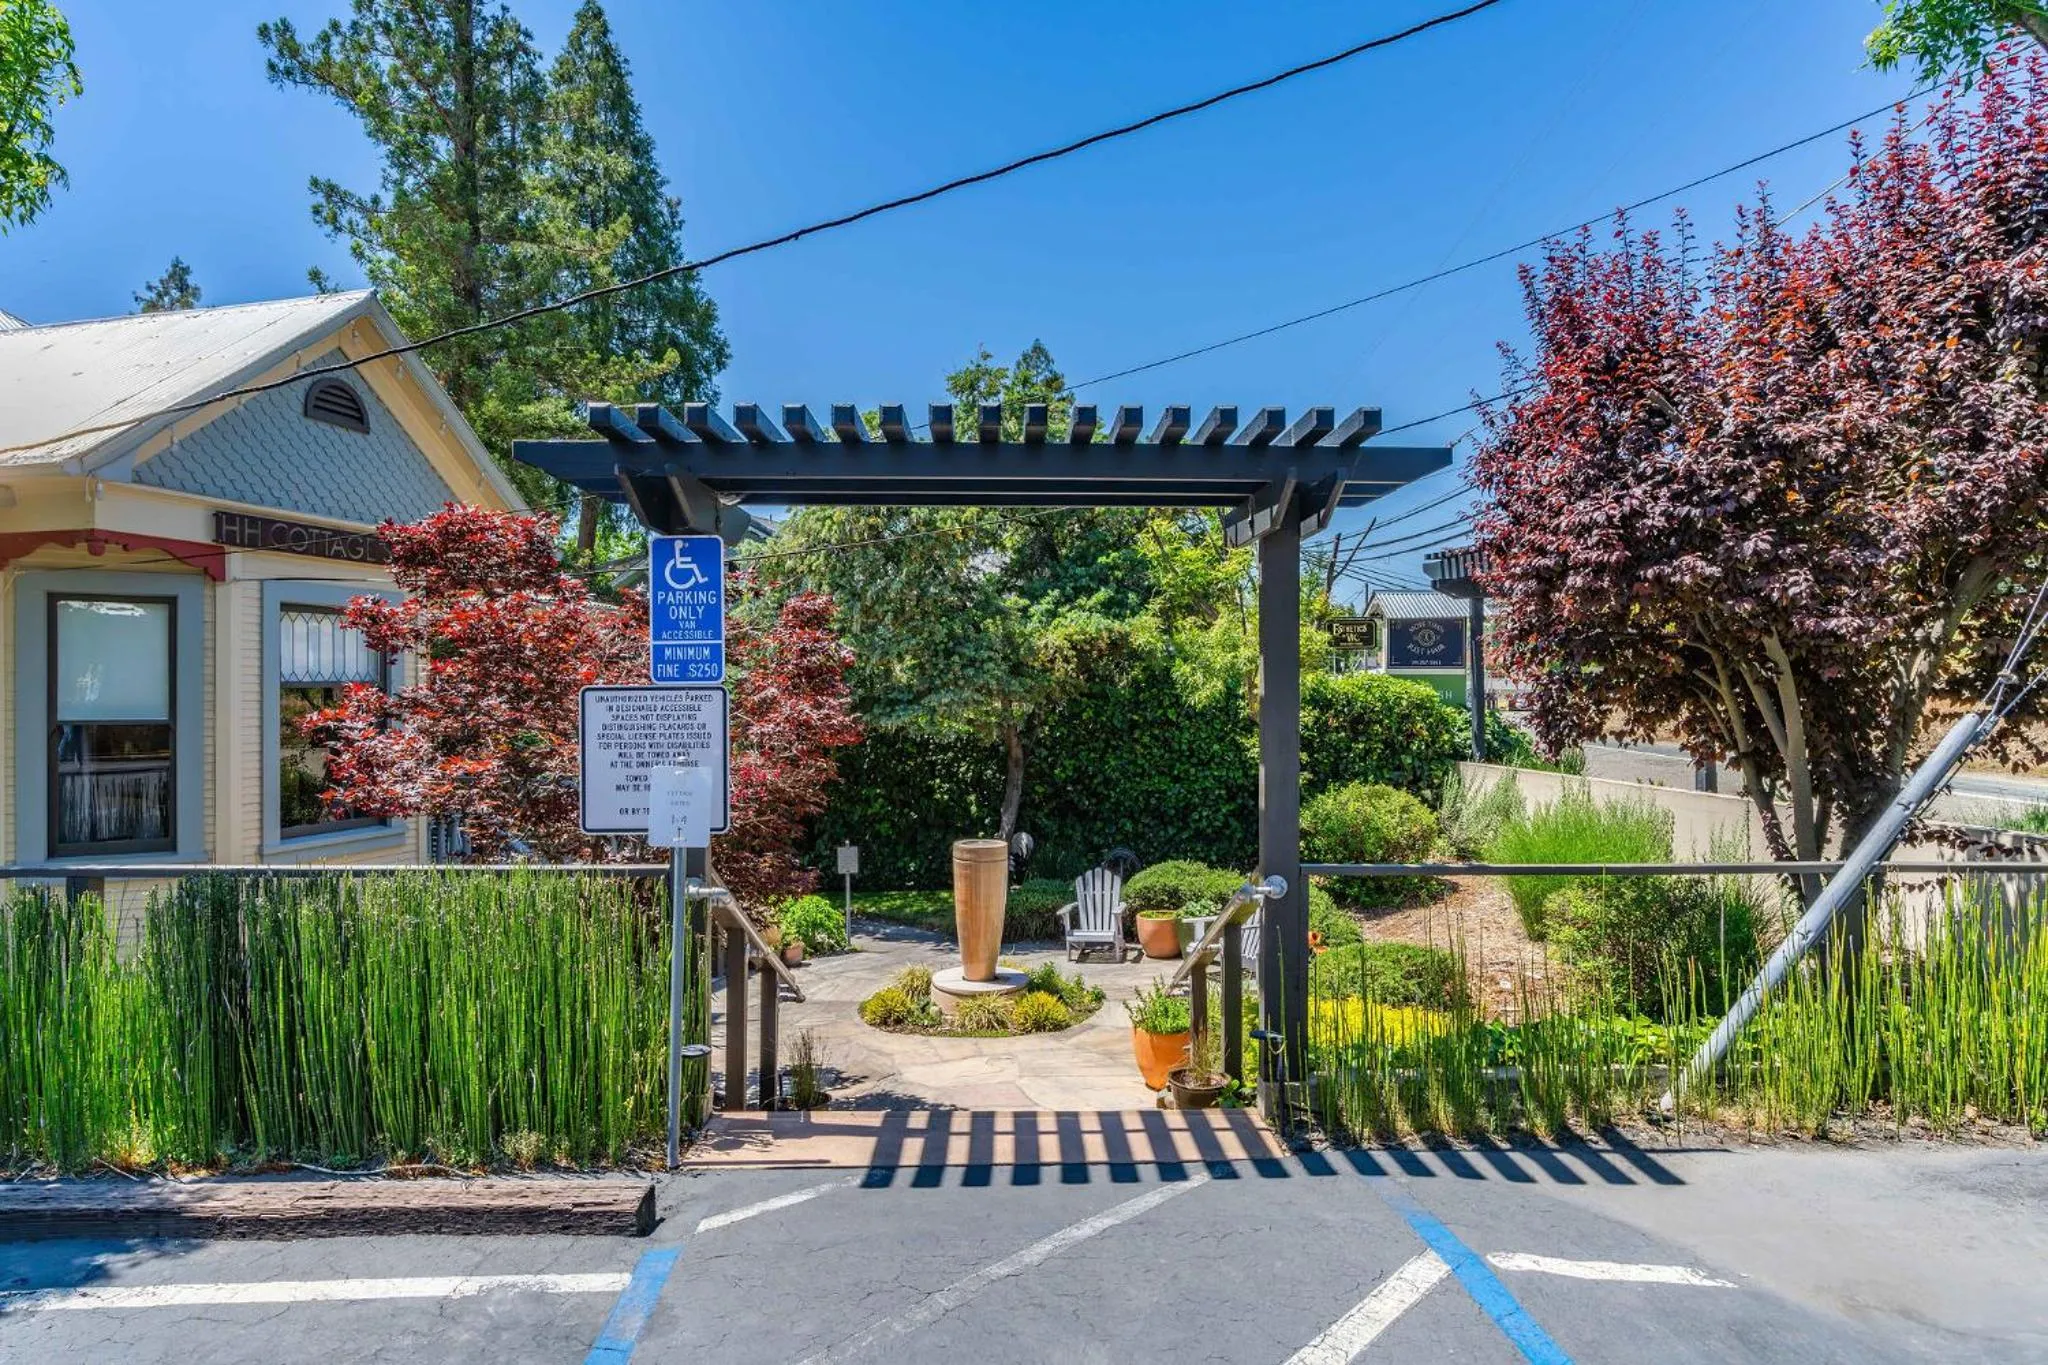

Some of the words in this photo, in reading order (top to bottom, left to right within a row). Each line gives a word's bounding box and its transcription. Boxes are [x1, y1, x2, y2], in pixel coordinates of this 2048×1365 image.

[222, 515, 262, 547] HH
[657, 591, 716, 605] PARKING
[669, 605, 705, 620] ONLY
[679, 621, 696, 629] VAN
[661, 630, 714, 640] ACCESSIBLE
[664, 647, 711, 660] MINIMUM
[657, 664, 680, 678] FINE
[687, 663, 718, 678] $250
[594, 695, 648, 703] UNAUTHORIZED
[650, 694, 683, 702] VEHICLES
[685, 694, 714, 702] PARKED
[605, 704, 613, 712] IN
[615, 704, 657, 712] DESIGNATED
[611, 713, 638, 721] SPACES
[640, 713, 654, 721] NOT
[656, 713, 697, 721] DISPLAYING
[601, 723, 656, 731] DISTINGUISHING
[659, 722, 694, 731] PLACARDS
[697, 722, 707, 730] OR
[597, 732, 625, 741] SPECIAL
[628, 732, 657, 740] LICENSE
[659, 732, 685, 740] PLATES
[687, 731, 712, 740] ISSUED
[599, 741, 613, 750] FOR
[614, 741, 646, 750] PERSONS
[648, 741, 665, 749] WITH
[667, 741, 711, 749] DISABILITIES
[618, 751, 634, 759] WILL
[636, 751, 644, 759] BE
[647, 751, 670, 759] TOWED
[610, 760, 618, 769] AT
[620, 760, 633, 769] THE
[625, 774, 649, 782] TOWED
[615, 784, 630, 792] MAY
[633, 784, 643, 792] BE
[619, 807, 629, 816] OR
[631, 807, 641, 815] BY
